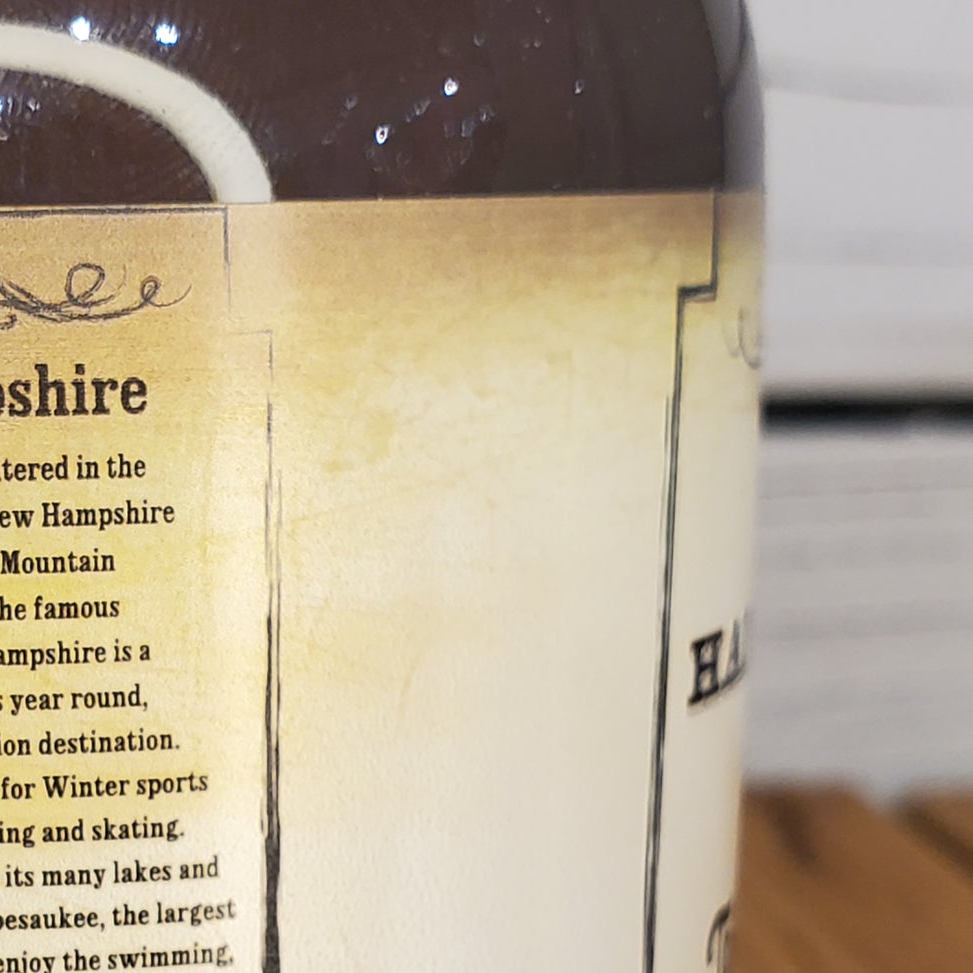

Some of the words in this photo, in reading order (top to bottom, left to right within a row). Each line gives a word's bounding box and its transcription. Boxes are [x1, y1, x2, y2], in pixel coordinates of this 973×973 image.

[106, 453, 146, 479] the
[41, 499, 175, 531] Hampshire
[0, 548, 116, 574] Mountain
[33, 595, 120, 620] famous
[9, 693, 64, 716] year
[71, 683, 148, 712] round,
[39, 727, 180, 755] destination.
[1, 776, 36, 800] for
[42, 774, 130, 799] Winter
[136, 771, 208, 800] sports
[42, 818, 85, 843] and
[92, 816, 185, 842] skating.
[5, 864, 34, 888] its
[42, 868, 106, 890] many
[113, 859, 172, 884] lakes
[112, 903, 150, 926] the
[157, 899, 236, 927] largest
[62, 949, 101, 972] the
